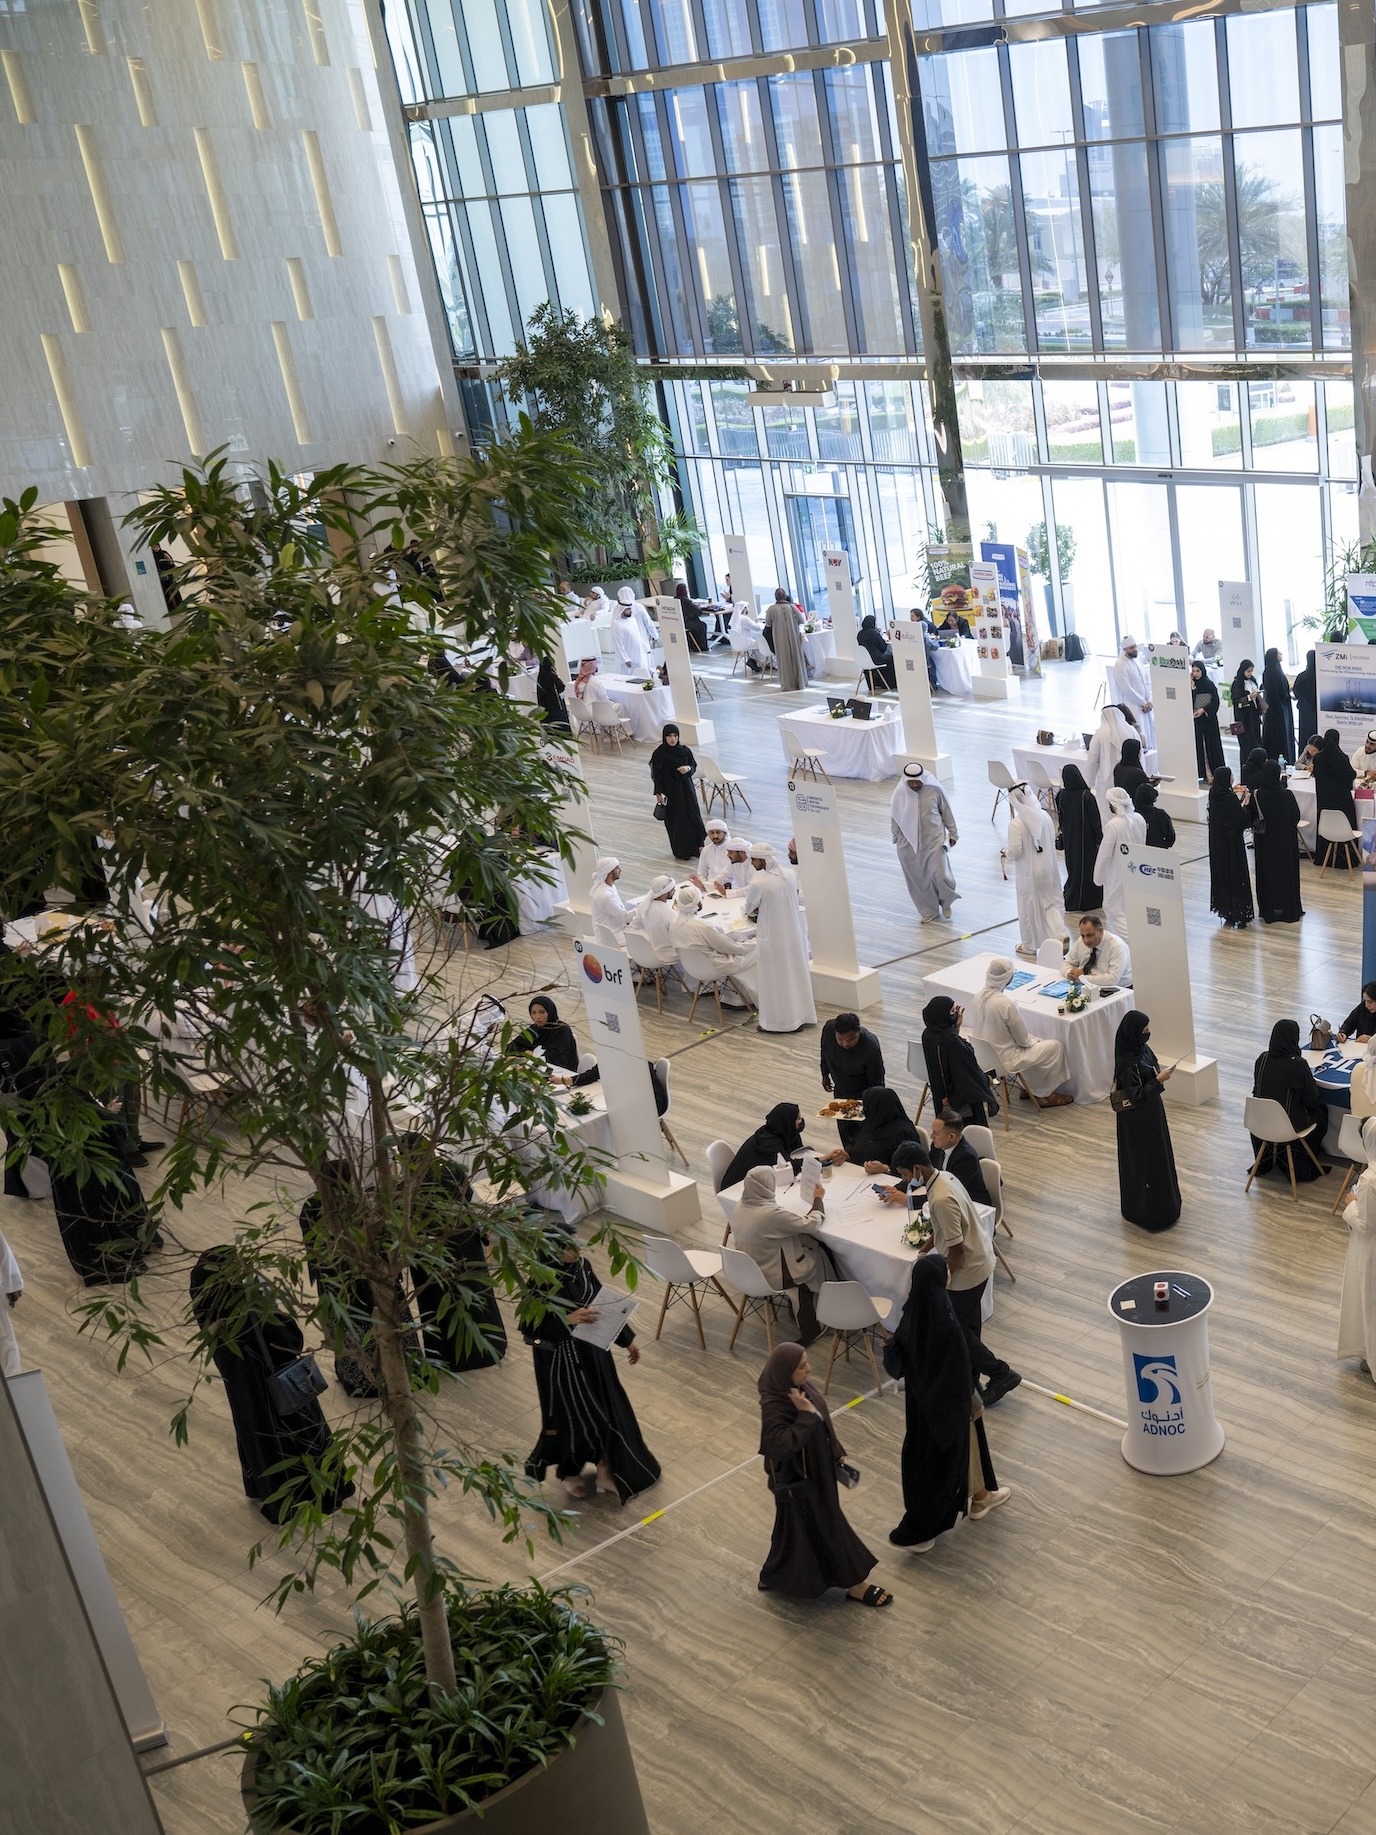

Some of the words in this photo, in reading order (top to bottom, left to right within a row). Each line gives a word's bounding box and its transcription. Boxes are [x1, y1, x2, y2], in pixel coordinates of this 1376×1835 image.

[930, 560, 949, 570] 100%
[932, 562, 966, 576] NATURAL
[935, 573, 952, 582] BEEF
[603, 964, 622, 985] brf
[1141, 1407, 1183, 1424] أدنوك
[1143, 1423, 1186, 1436] ADNOC
